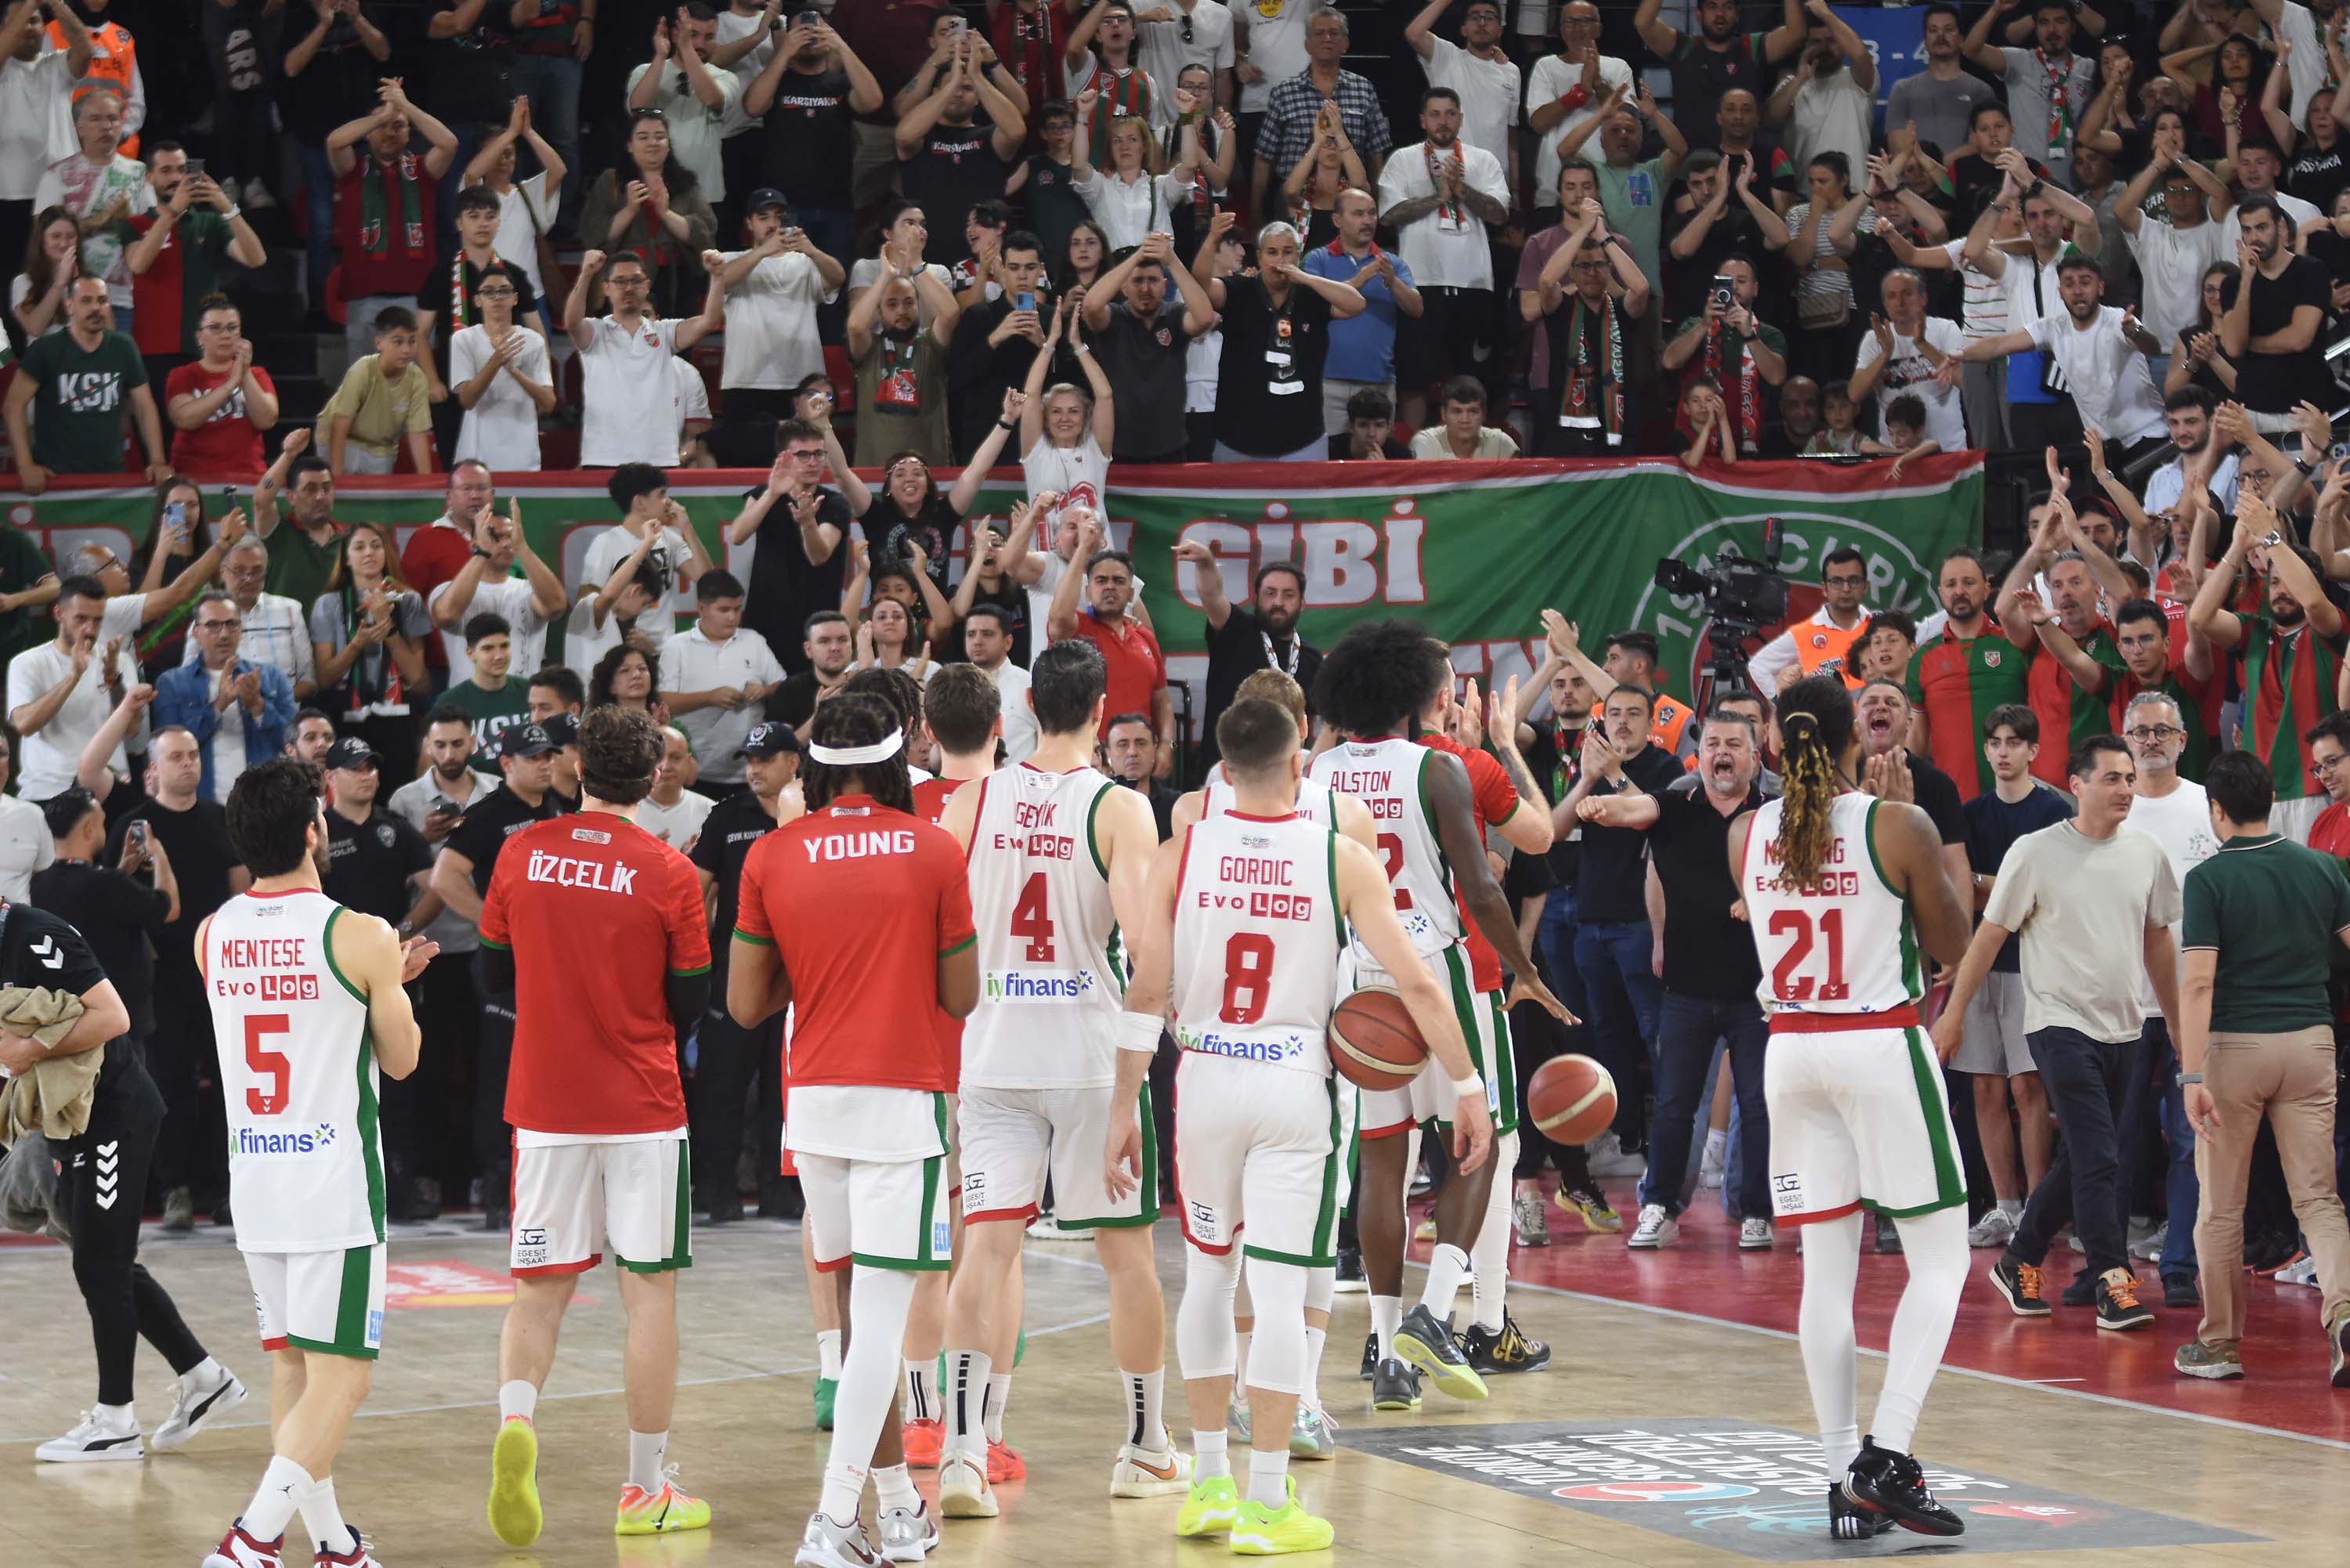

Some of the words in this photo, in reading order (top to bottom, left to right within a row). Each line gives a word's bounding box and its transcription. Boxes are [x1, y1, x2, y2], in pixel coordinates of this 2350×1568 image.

[58, 372, 120, 412] KSK
[1330, 771, 1392, 793] ALSTON
[1016, 800, 1058, 829] GEYİK
[803, 831, 915, 863] YOUNG
[527, 850, 638, 894] ÖZÇELİK
[1220, 856, 1293, 886] GORDIC
[1010, 873, 1055, 962] 4
[222, 938, 306, 969] MENTEŞE
[1769, 909, 1849, 1000] 21
[1219, 932, 1275, 1024] 8
[244, 1014, 291, 1115] 5
